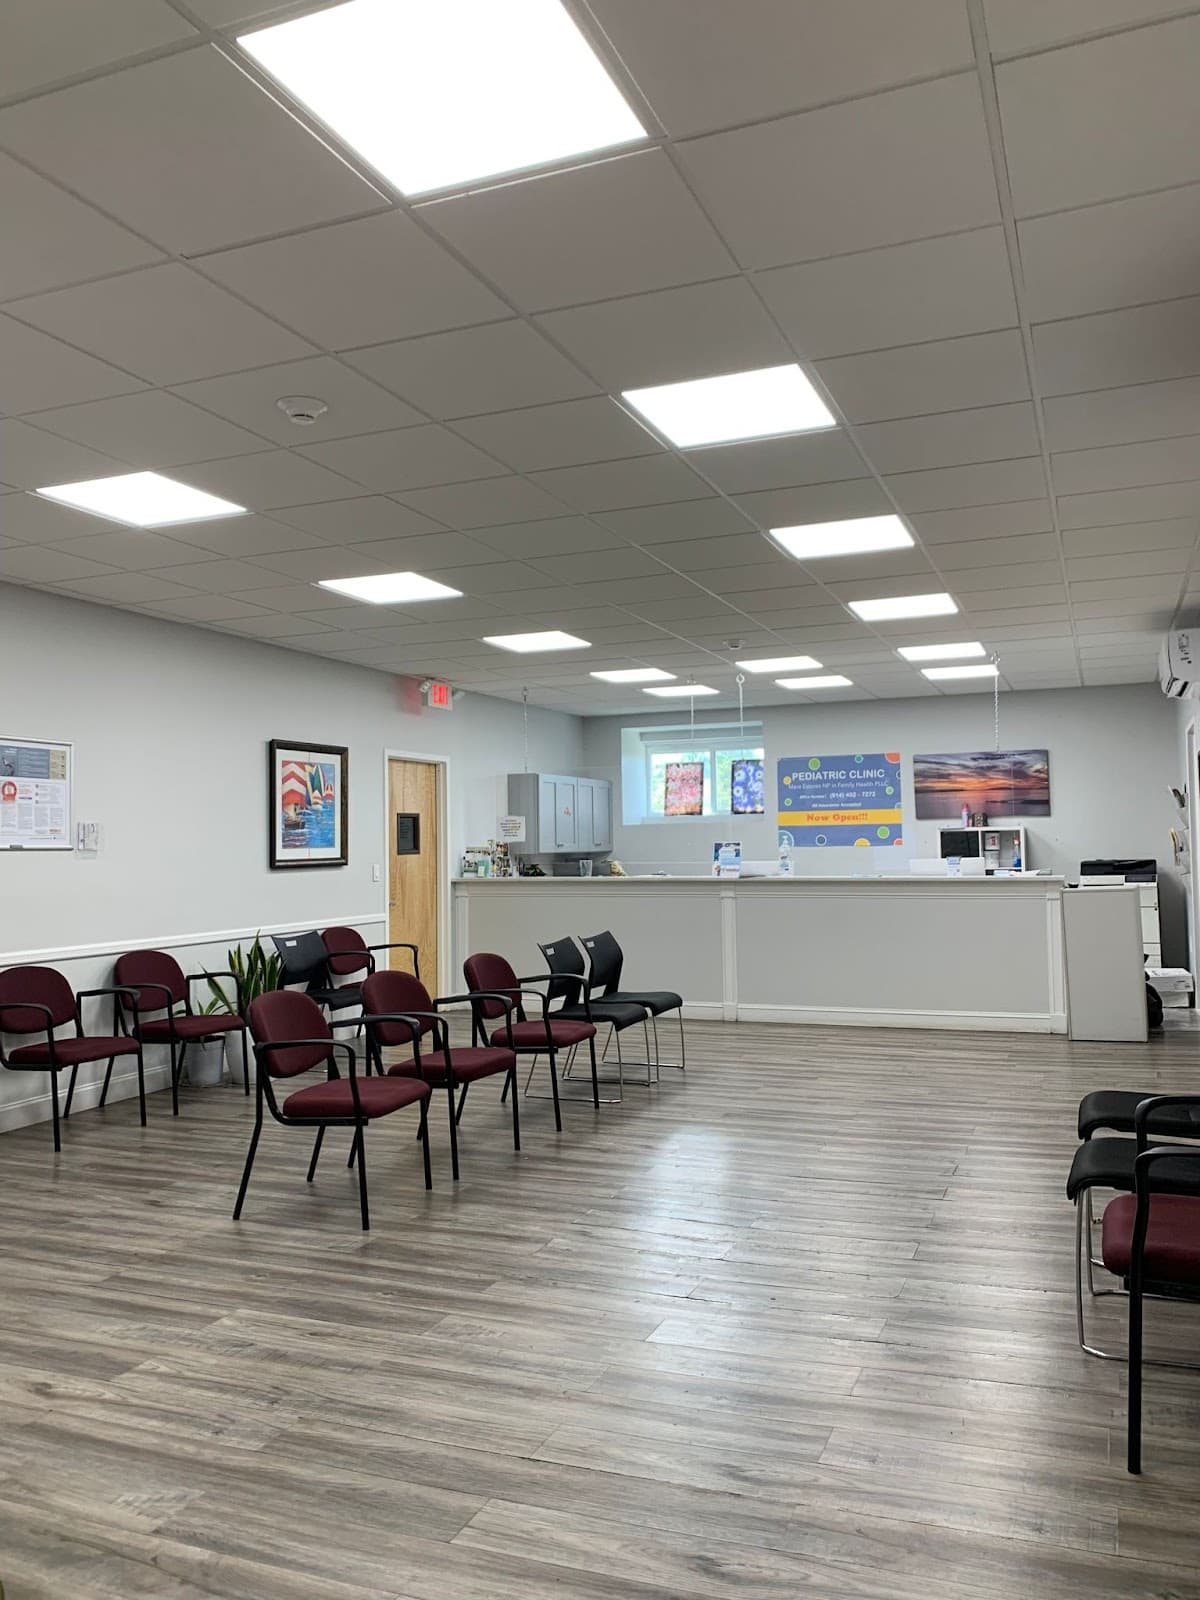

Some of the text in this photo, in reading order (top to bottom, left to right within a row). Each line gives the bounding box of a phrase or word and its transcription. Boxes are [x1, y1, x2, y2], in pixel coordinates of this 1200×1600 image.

[432, 683, 449, 705] EXIT
[792, 769, 885, 781] PEDIATRIC CLINIC
[805, 813, 869, 823] Now Open!!!
